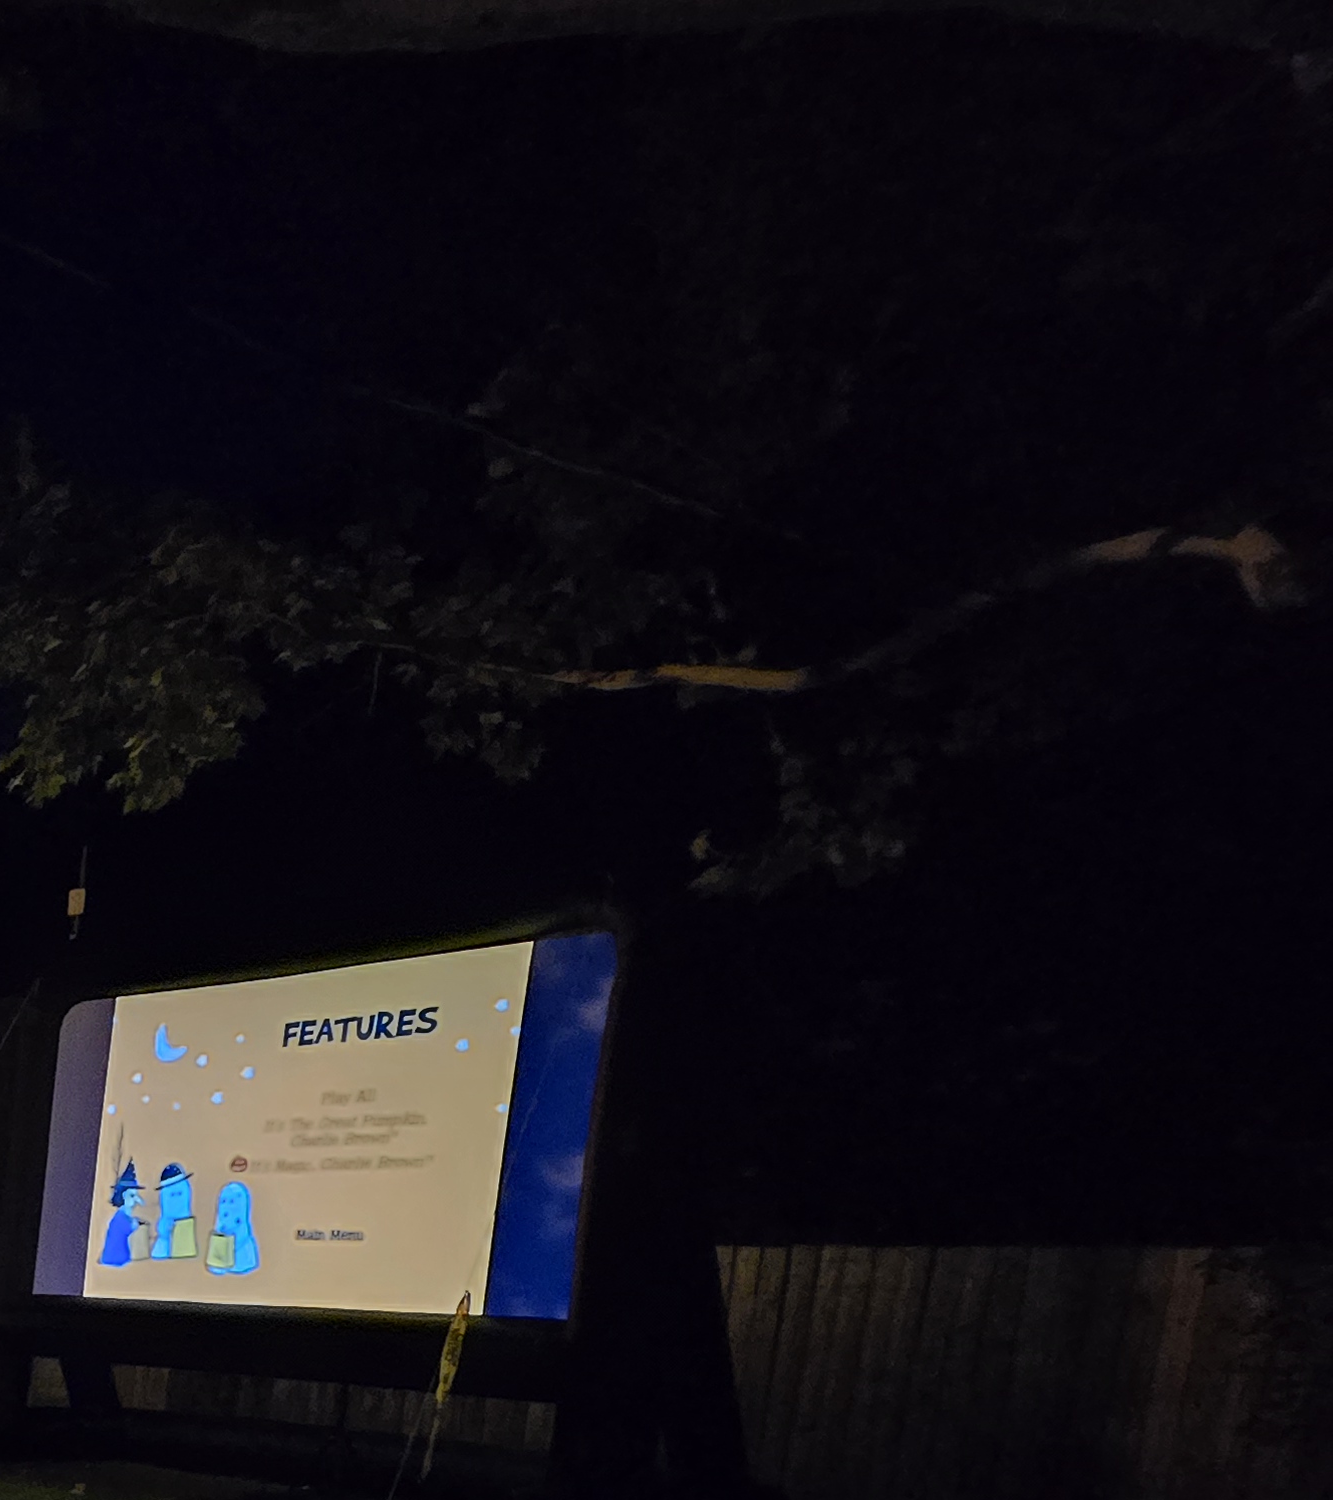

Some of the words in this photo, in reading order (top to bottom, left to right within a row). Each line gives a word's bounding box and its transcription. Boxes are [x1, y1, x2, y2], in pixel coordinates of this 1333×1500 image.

[282, 1007, 440, 1047] FEATURES
[356, 1088, 377, 1102] All
[295, 1229, 325, 1241] Main
[329, 1229, 364, 1241] Menu
